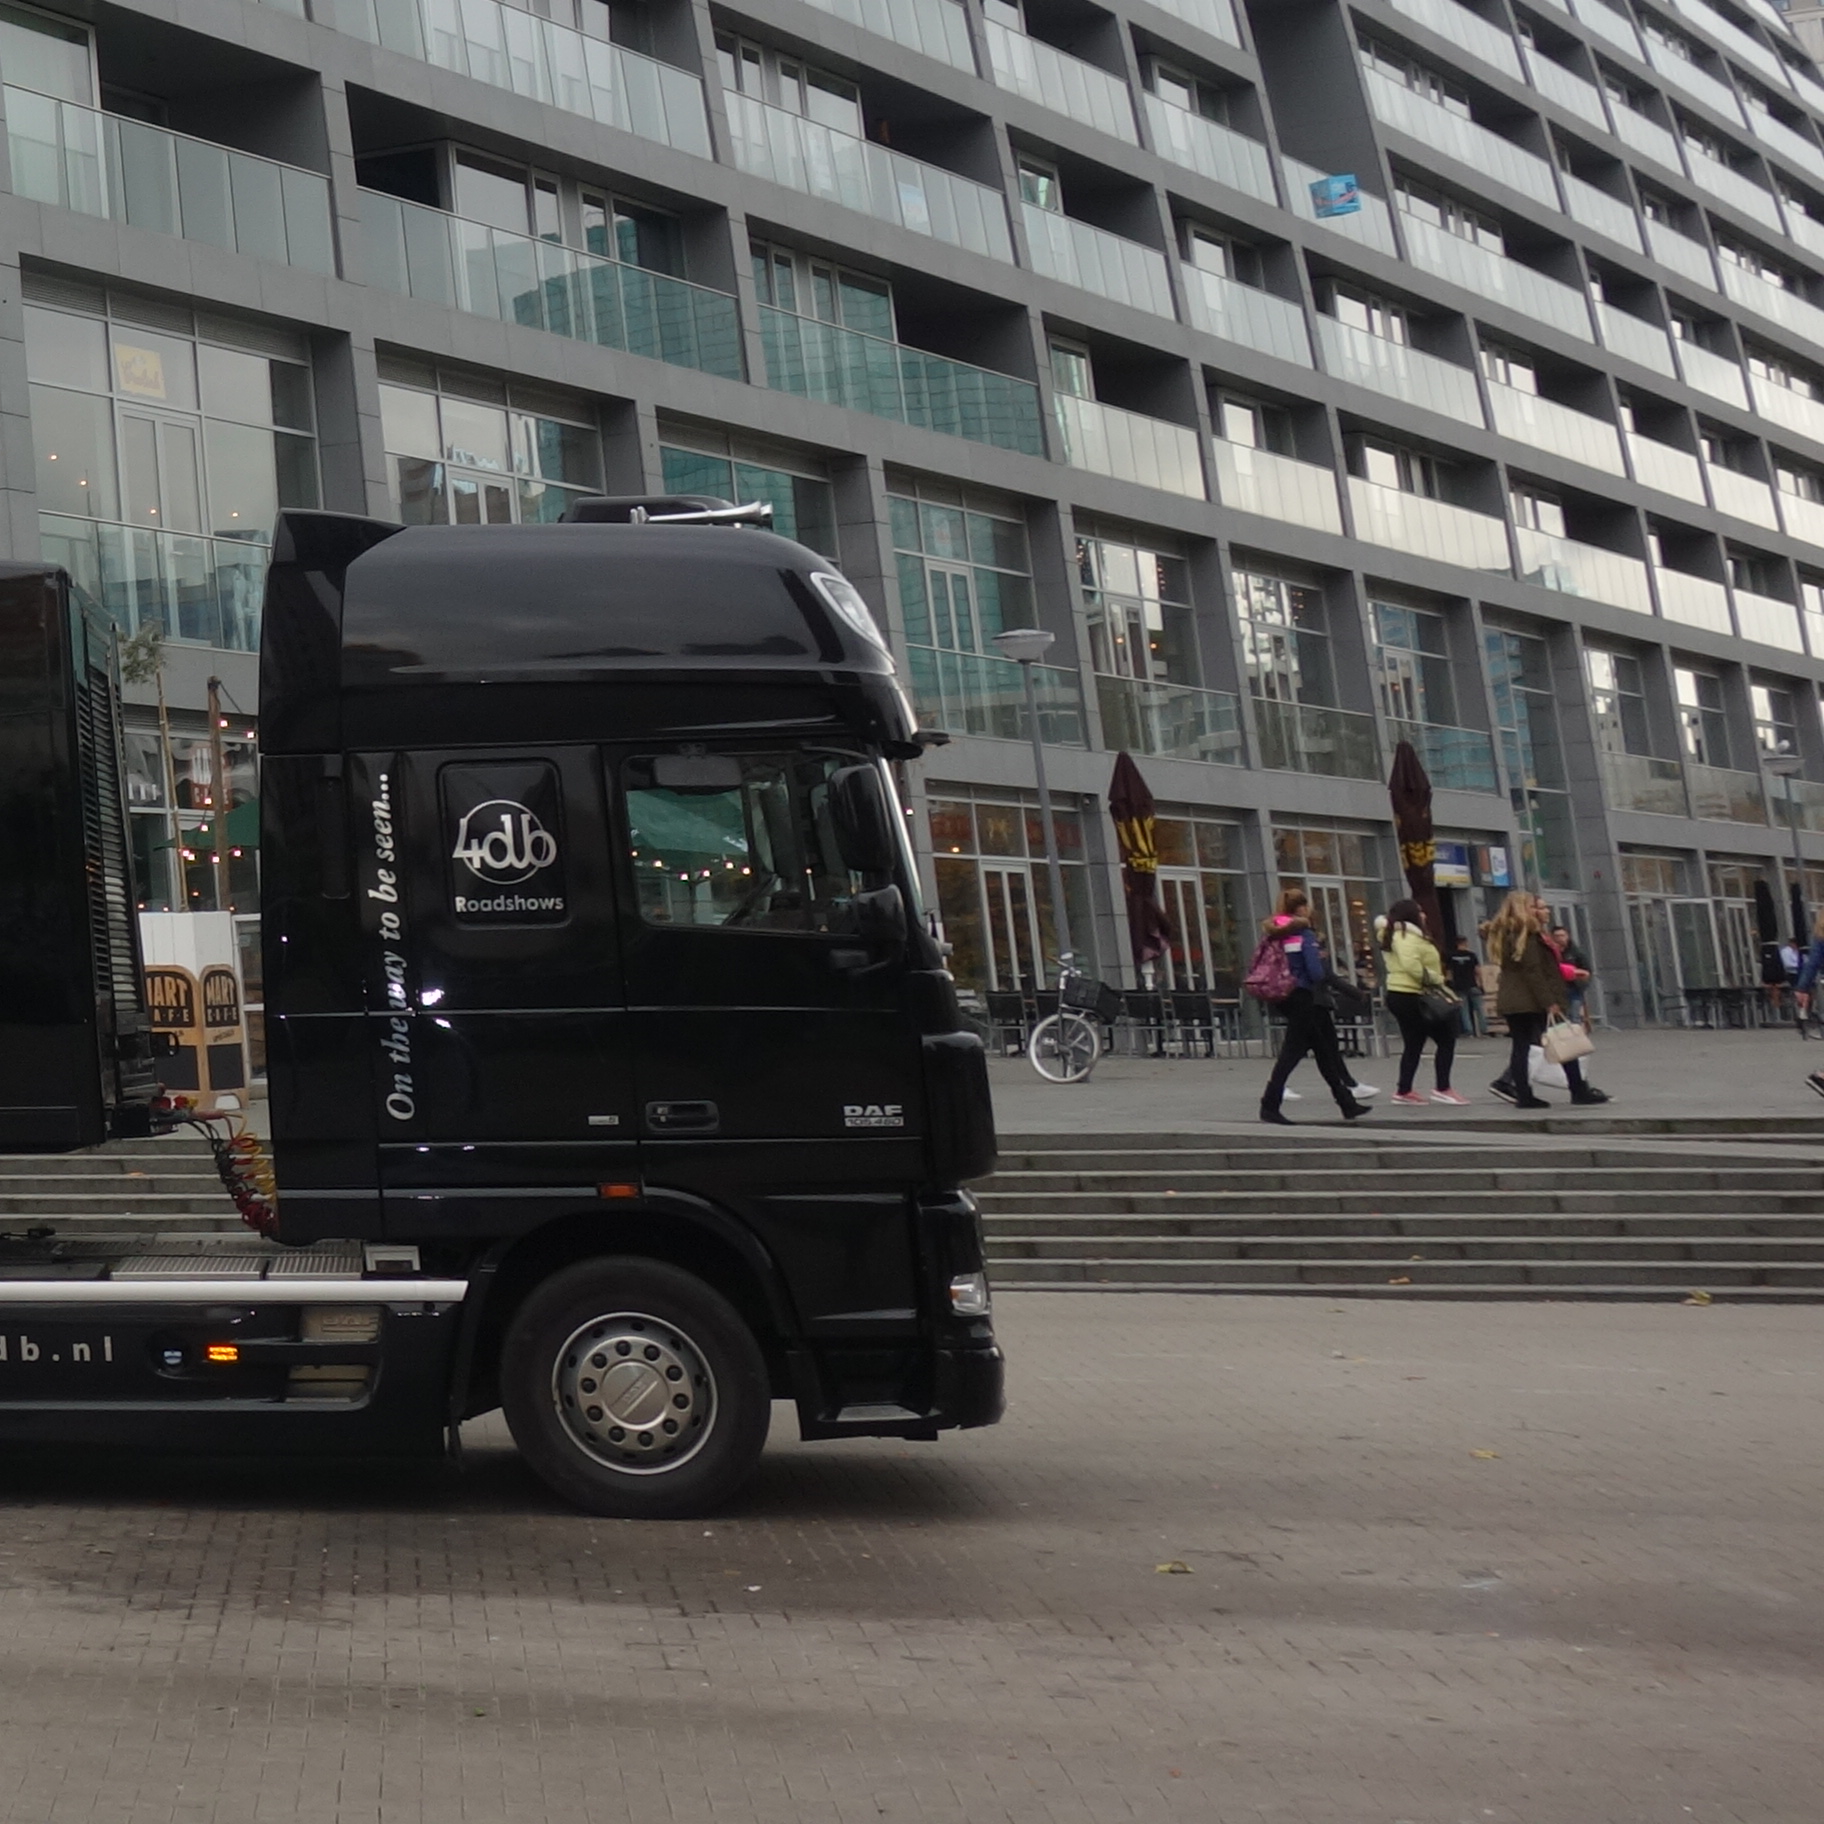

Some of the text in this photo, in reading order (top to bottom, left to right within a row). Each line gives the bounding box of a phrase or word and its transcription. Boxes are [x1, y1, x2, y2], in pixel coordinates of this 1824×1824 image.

[455, 894, 564, 913] Roadshows
[367, 773, 415, 1121] On the way to be seen...
[843, 1105, 903, 1117] DAF
